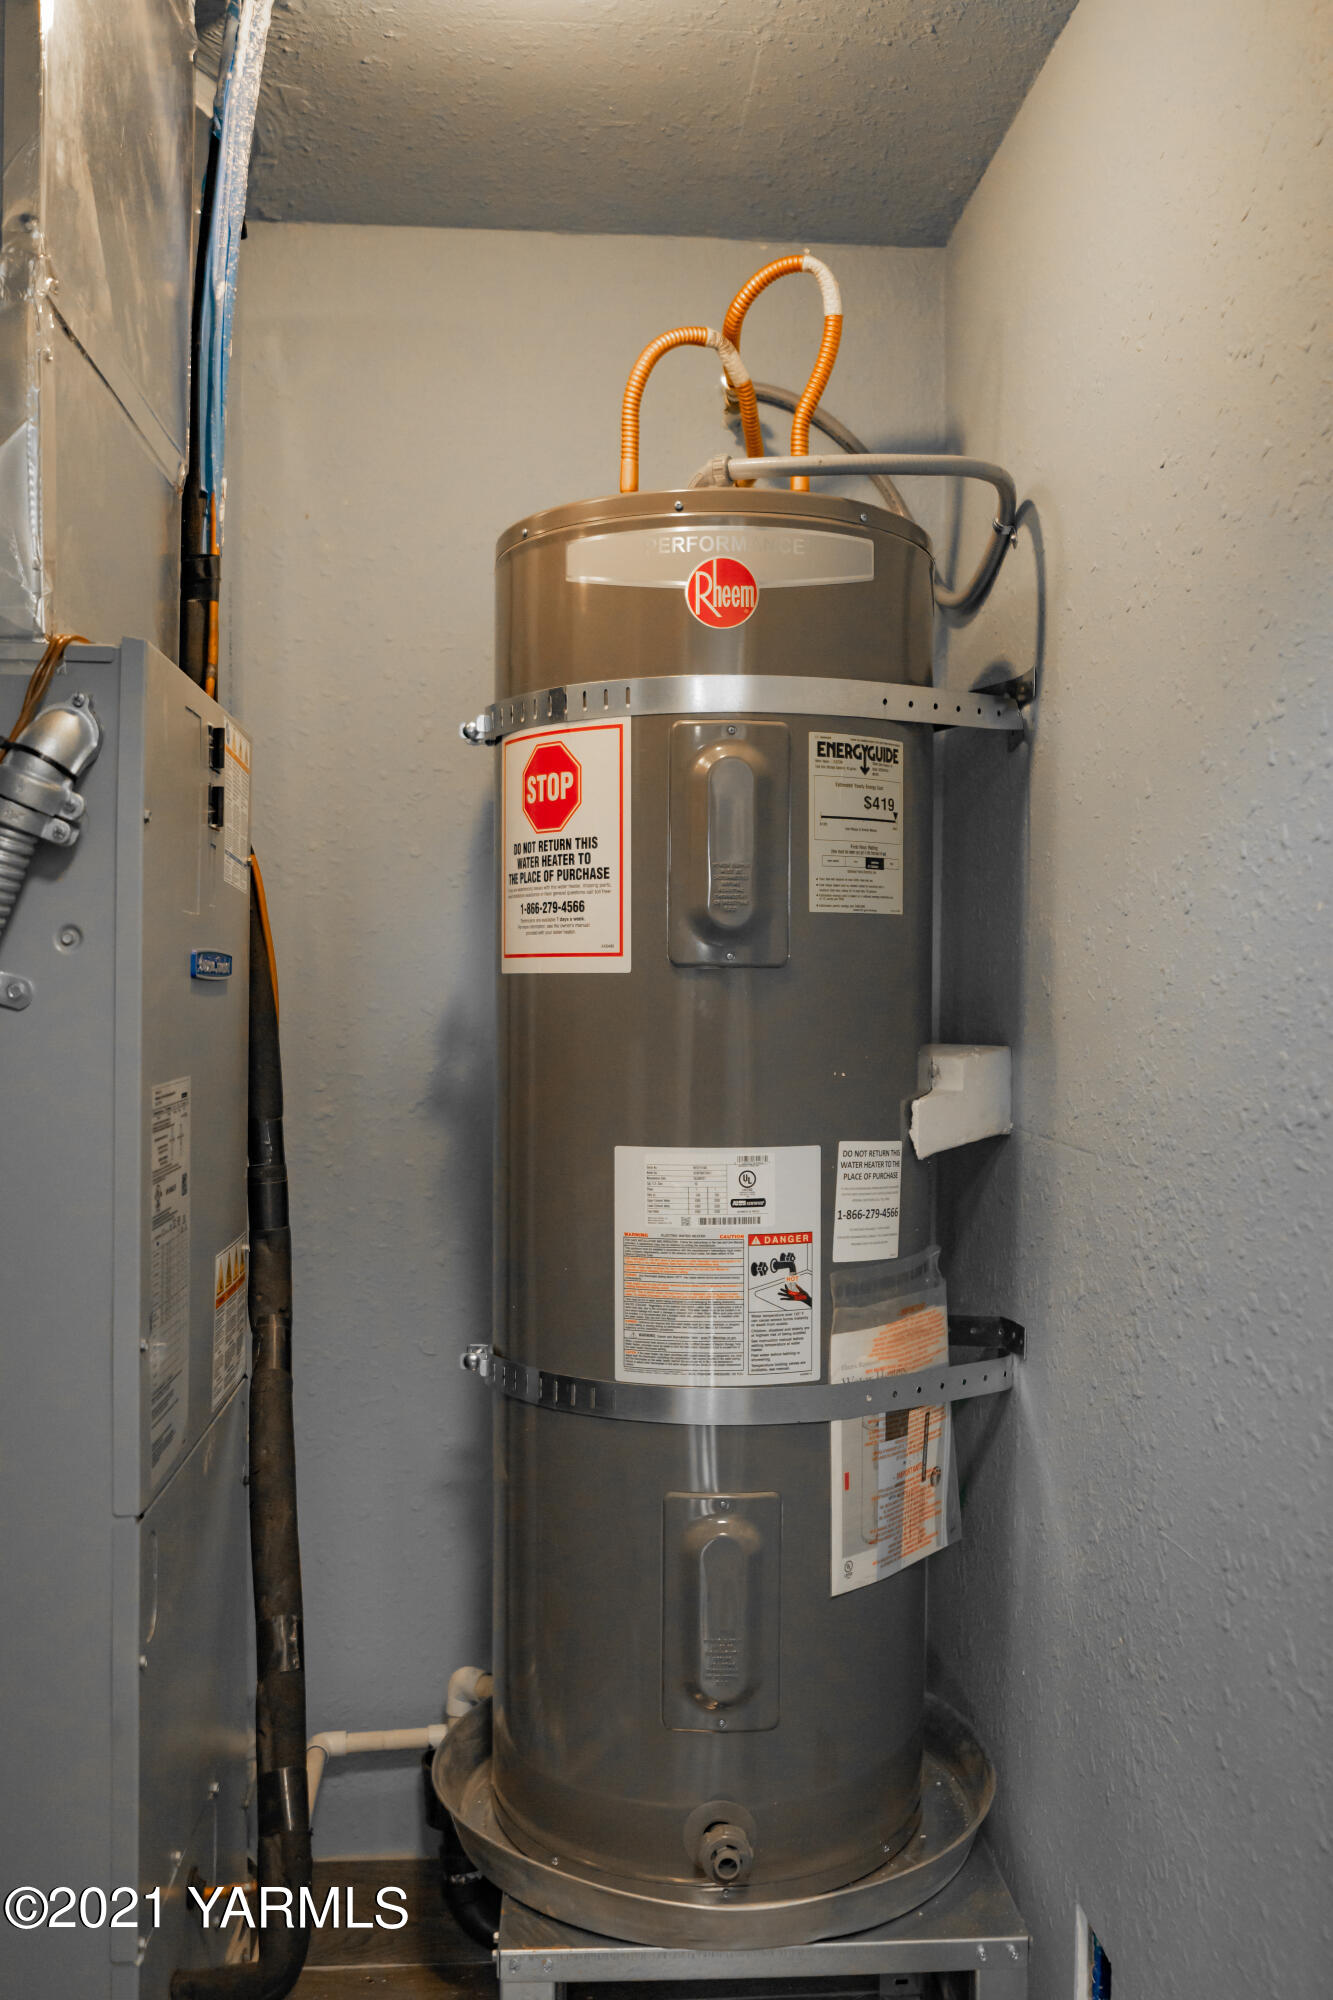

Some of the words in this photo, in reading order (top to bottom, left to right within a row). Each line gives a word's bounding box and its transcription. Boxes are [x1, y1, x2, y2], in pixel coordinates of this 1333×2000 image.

[695, 559, 754, 617] Rheem
[527, 771, 574, 804] STOP
[513, 843, 522, 855] DO
[523, 841, 536, 854] NOT
[538, 838, 572, 852] RETURN
[575, 836, 598, 849] THIS
[517, 856, 539, 870] WATER
[541, 853, 575, 867] HEATER
[578, 852, 591, 865] TO
[509, 873, 518, 885] THE
[520, 870, 541, 884] PLACE
[543, 869, 554, 882] OF
[557, 867, 610, 881] PURCHASE
[520, 900, 585, 915] 1-866-279-4566
[842, 1150, 853, 1158] DO
[854, 1150, 868, 1158] NOT
[868, 1149, 890, 1157] RETURN
[840, 1161, 863, 1169] WATER
[864, 1161, 884, 1169] HEATER
[843, 1173, 862, 1181] PLACE
[863, 1172, 872, 1180] OF
[872, 1171, 898, 1180] PURCHASE
[837, 1207, 899, 1220] 1-866-279-4566
[764, 1234, 809, 1244] DANGER
